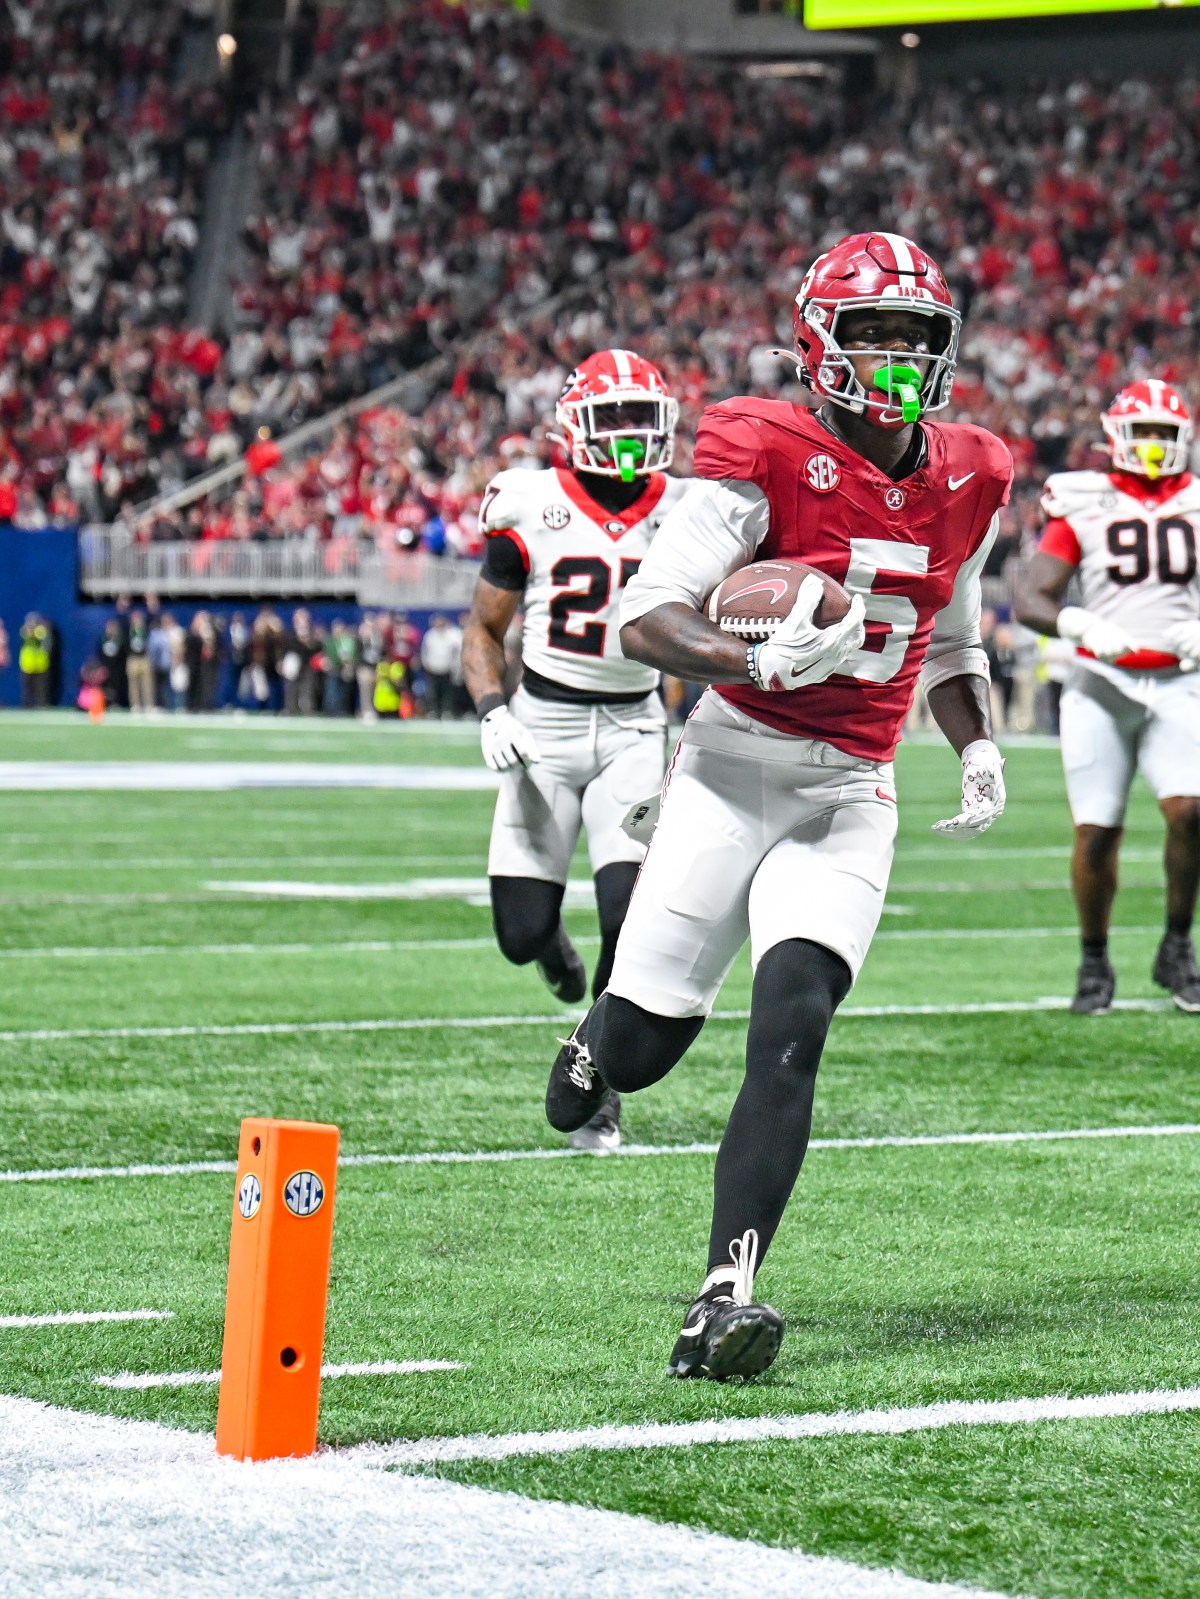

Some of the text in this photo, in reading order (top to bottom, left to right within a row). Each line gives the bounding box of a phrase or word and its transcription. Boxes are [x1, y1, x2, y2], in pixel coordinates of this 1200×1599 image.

[898, 286, 924, 298] BAMA
[807, 455, 839, 490] SEC
[545, 505, 570, 528] SEC
[1107, 517, 1196, 584] 90
[836, 537, 930, 683] 5
[239, 1175, 260, 1217] SEC
[284, 1172, 324, 1215] SEC
